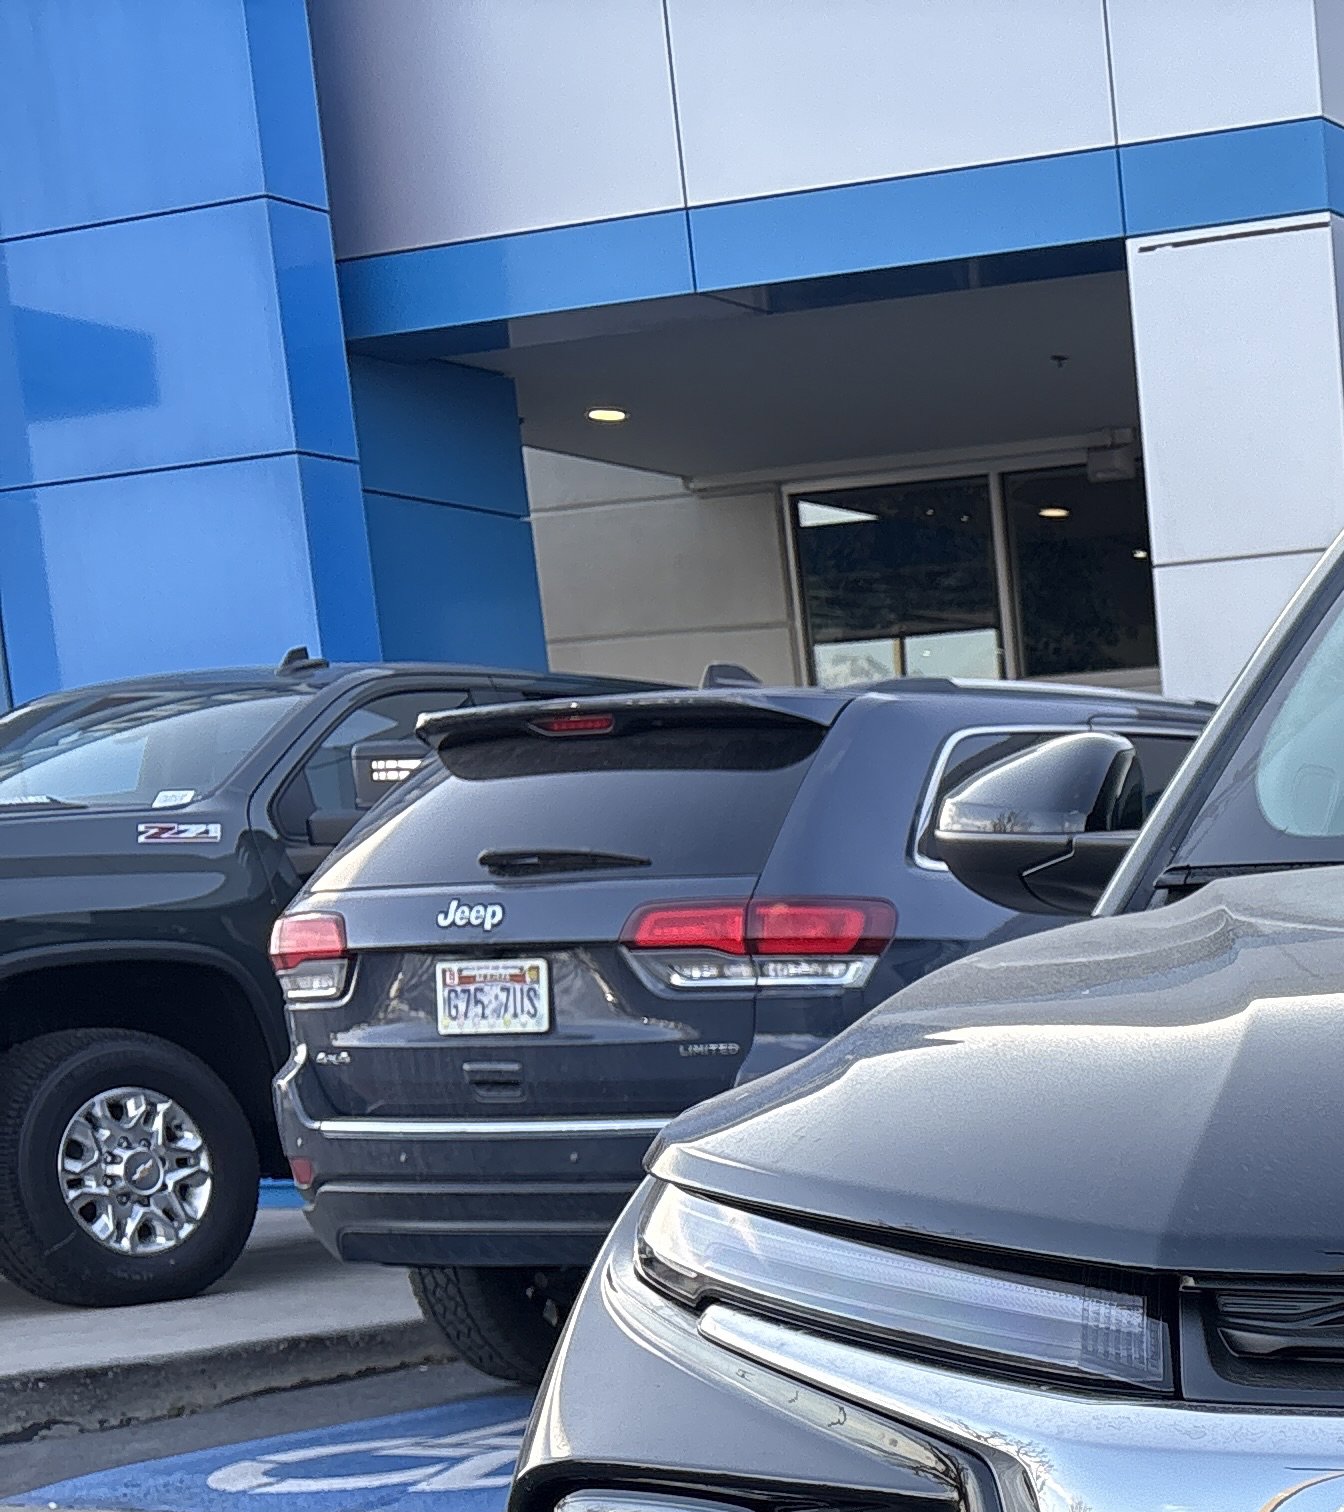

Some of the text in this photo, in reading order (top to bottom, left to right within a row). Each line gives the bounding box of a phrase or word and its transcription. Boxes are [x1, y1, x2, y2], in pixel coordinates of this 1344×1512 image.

[137, 823, 221, 843] Z71
[437, 899, 503, 930] Jeep
[679, 1043, 740, 1056] LIMITED
